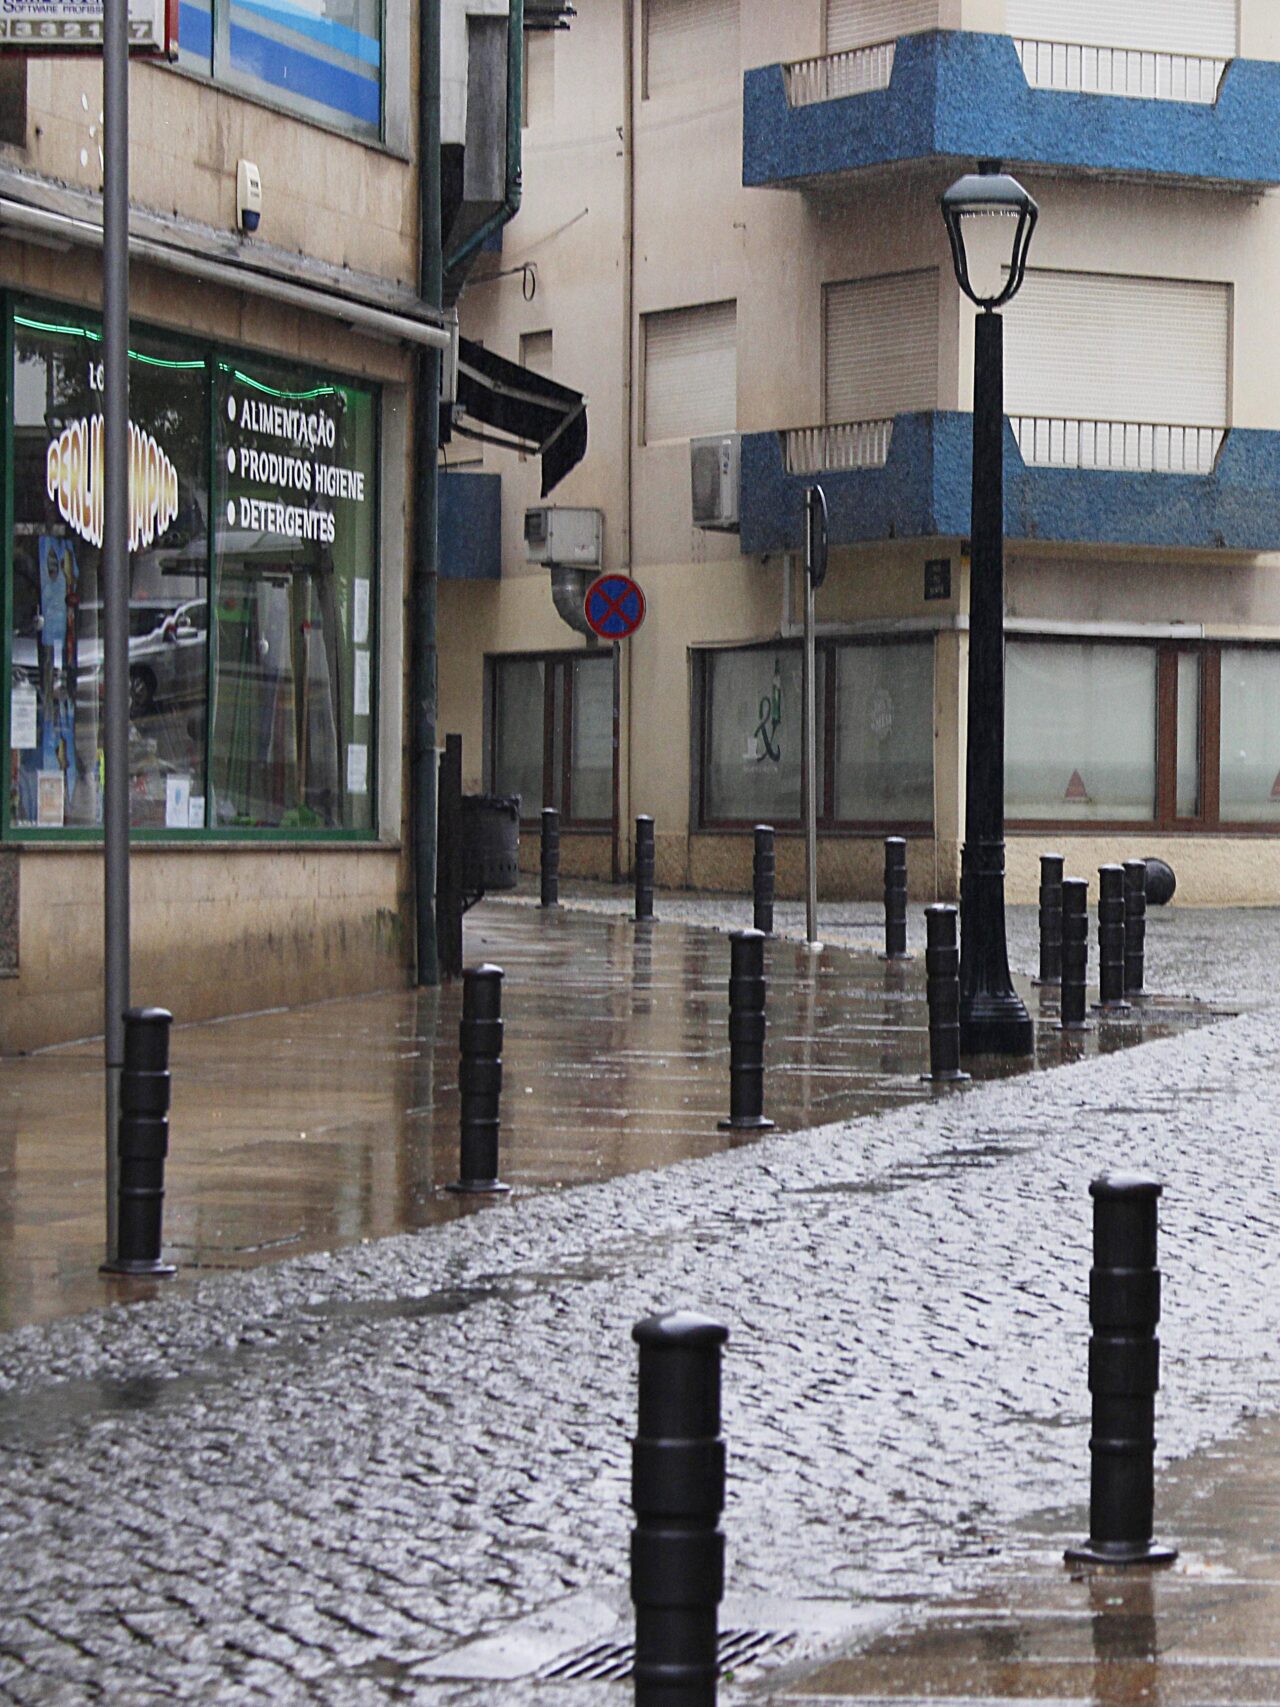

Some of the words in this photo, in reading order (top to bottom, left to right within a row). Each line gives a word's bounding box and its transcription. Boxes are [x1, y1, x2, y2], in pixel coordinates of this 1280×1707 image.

[14, 21, 149, 38] 33217
[240, 398, 335, 453] ALIMENTAÇÃO
[240, 447, 311, 491] PRODUTOS
[314, 462, 365, 501] HIGIENE
[240, 496, 335, 543] DETERGENTES
